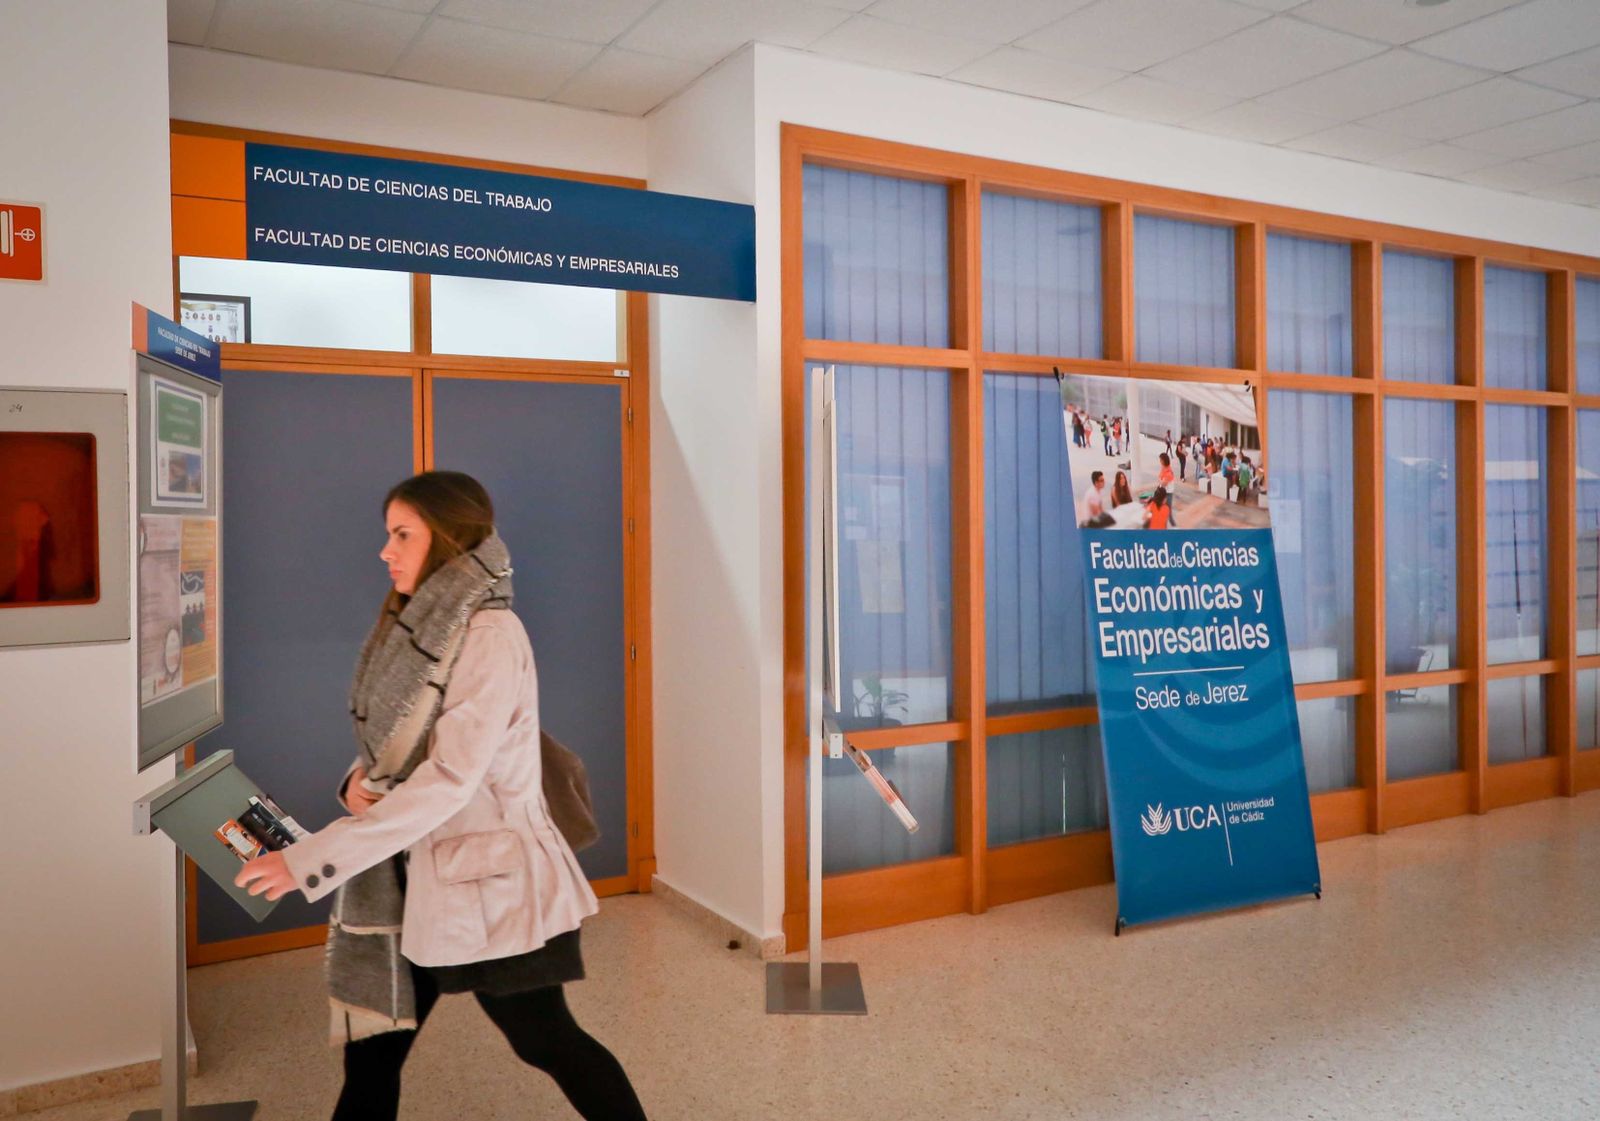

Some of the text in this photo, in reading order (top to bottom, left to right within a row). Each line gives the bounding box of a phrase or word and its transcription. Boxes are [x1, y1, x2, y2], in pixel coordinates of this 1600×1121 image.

[253, 166, 552, 212] FACULTAD DE CIENCIAS DEL TRABAJO
[254, 227, 679, 279] FACULTAD DE CIENCIAS ECONÓMICAS Y EMPRESARIALES
[1090, 541, 1259, 570] Facultad de Ciencias
[1094, 575, 1264, 614] Económicas y
[1098, 615, 1270, 664] Empresariales
[1135, 682, 1249, 710] Sede de Jerez
[1172, 803, 1222, 832] UCA
[1226, 796, 1275, 812] Universidad
[1228, 810, 1265, 825] de Cádiz
